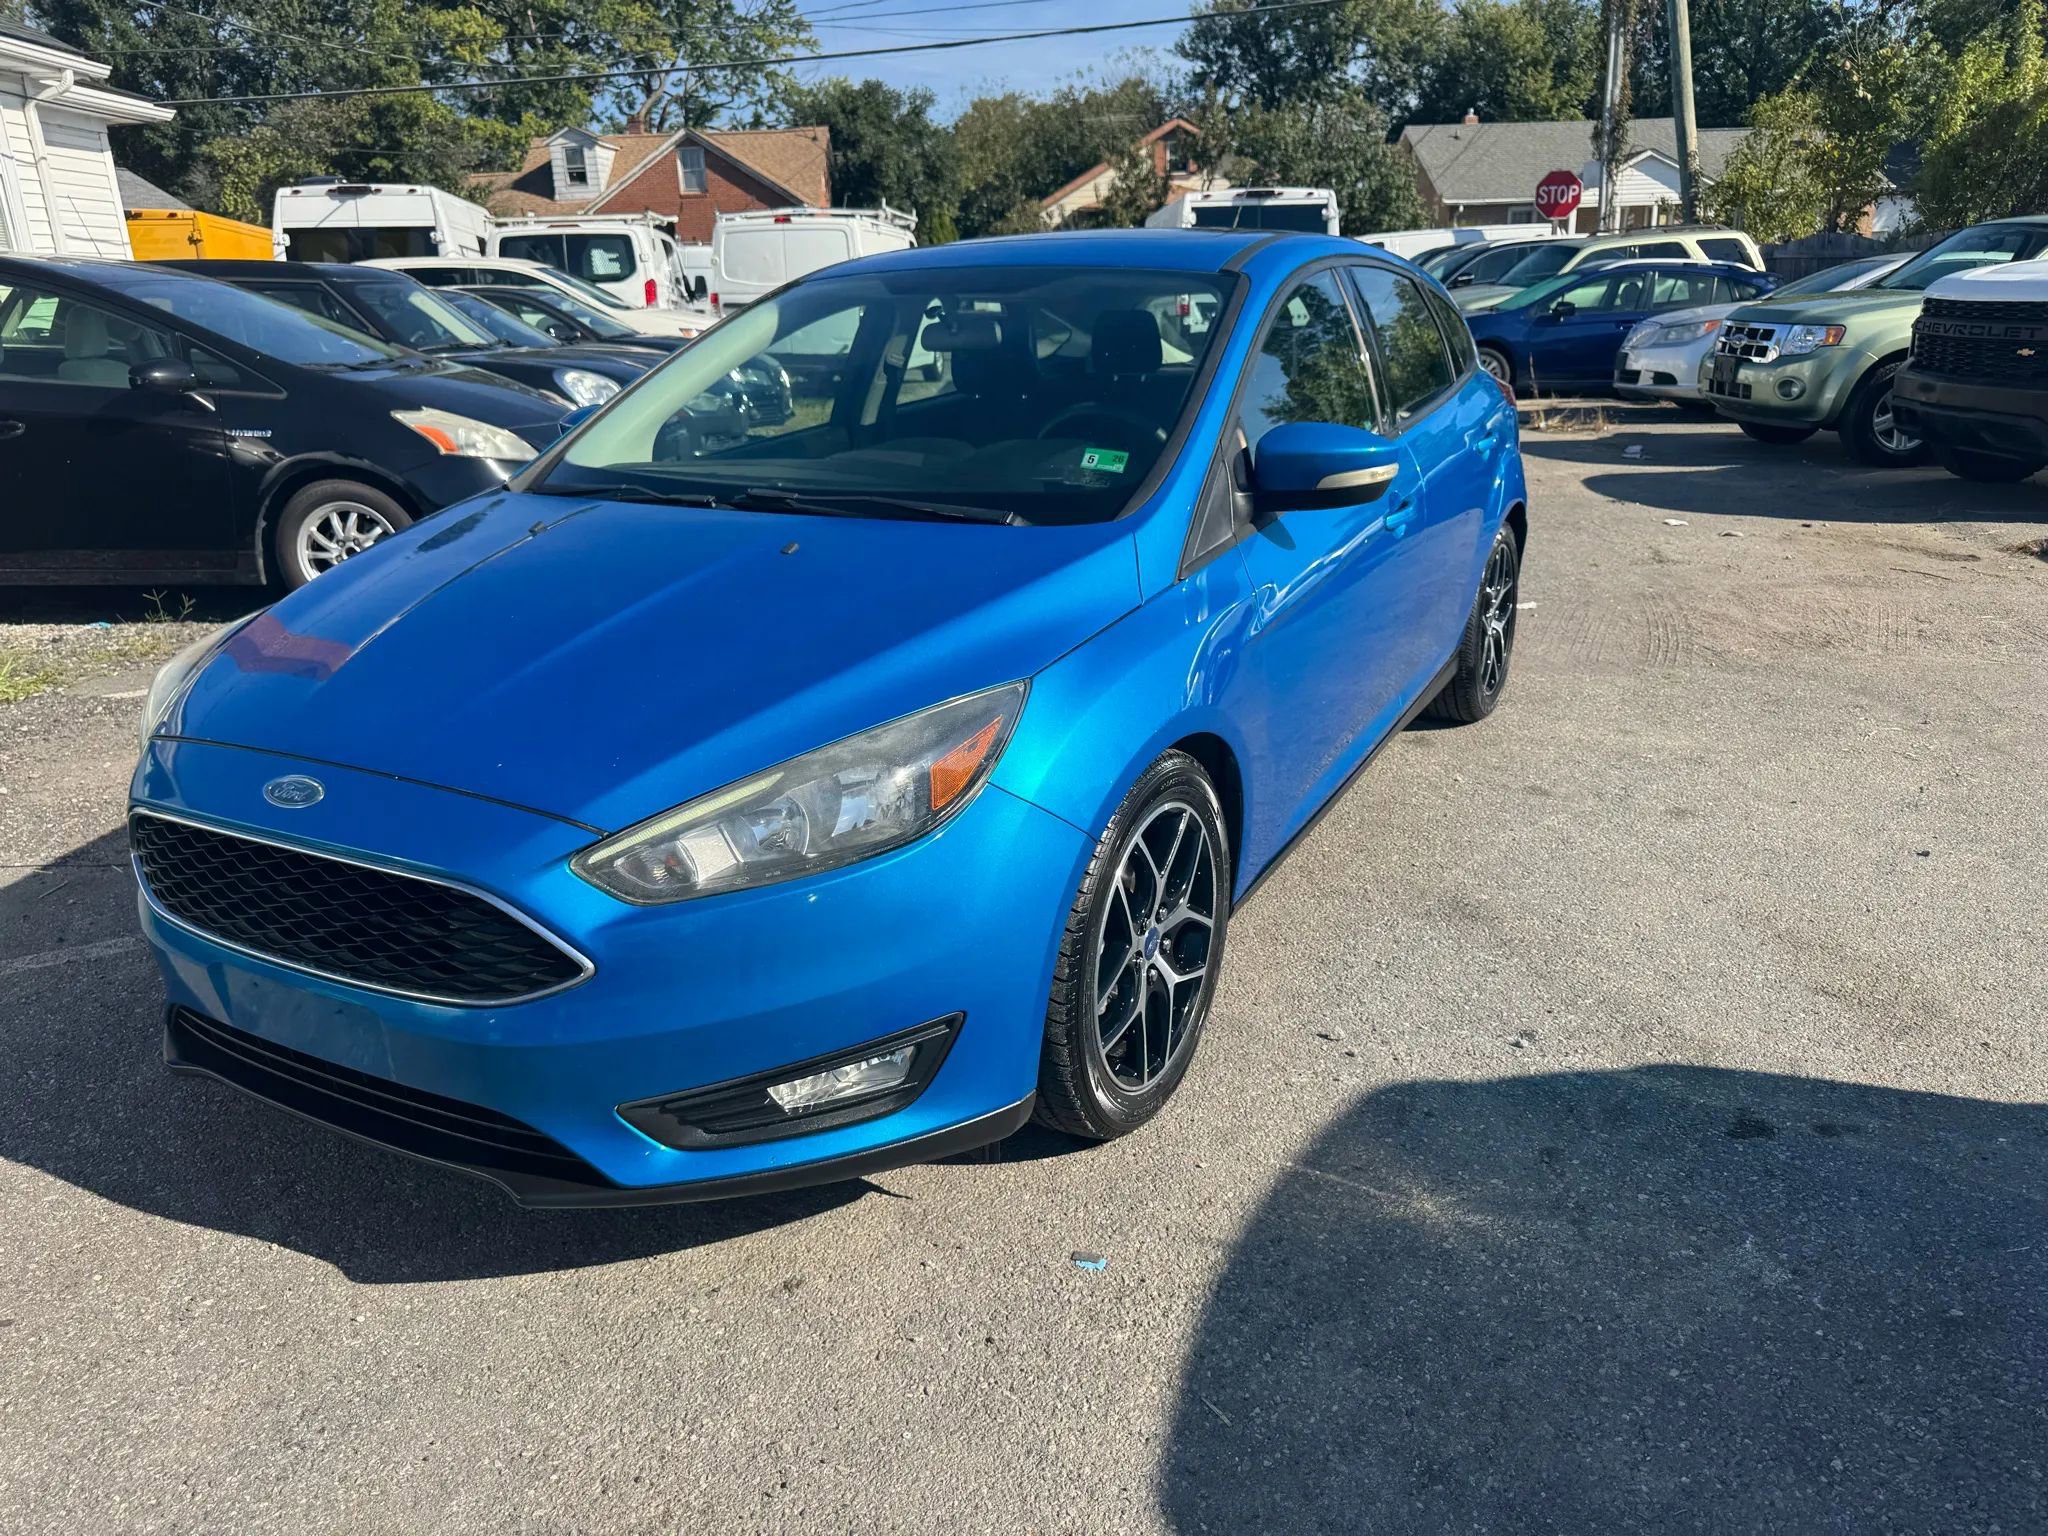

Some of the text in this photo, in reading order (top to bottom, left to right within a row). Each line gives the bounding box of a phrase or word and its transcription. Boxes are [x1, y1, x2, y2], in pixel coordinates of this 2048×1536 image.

[1537, 185, 1579, 204] STOP
[1915, 320, 2043, 338] CHEVROLET
[1087, 454, 1096, 464] 5
[274, 781, 311, 801] Ford
